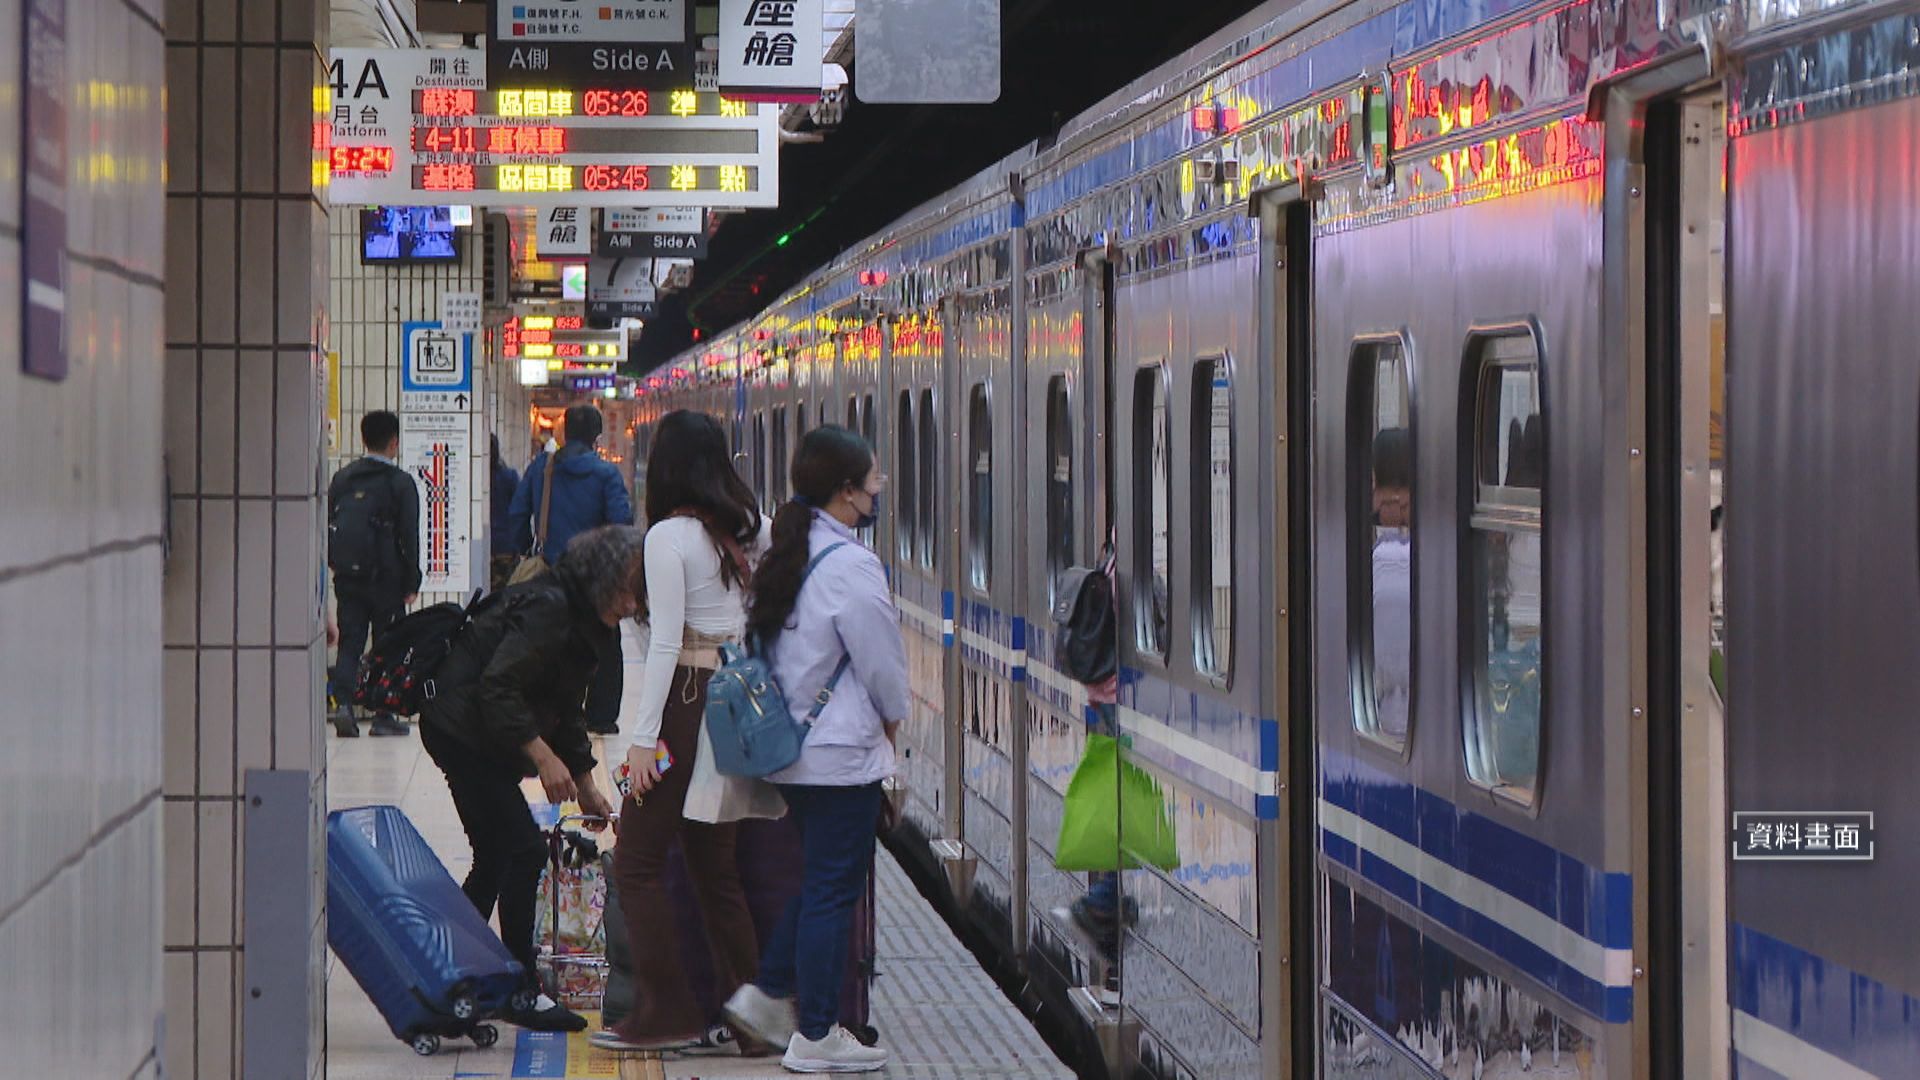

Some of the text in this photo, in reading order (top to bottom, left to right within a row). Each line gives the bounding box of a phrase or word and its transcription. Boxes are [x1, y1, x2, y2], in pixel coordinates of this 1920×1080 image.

[430, 57, 470, 75] 開往
[509, 47, 549, 70] A側
[592, 49, 674, 71] Side A
[415, 75, 484, 87] Destination
[499, 88, 573, 117] 區間車
[584, 90, 648, 117] 05:26
[480, 117, 551, 127] Train Message
[426, 126, 475, 153] 4-11
[509, 155, 561, 164] Next Train
[499, 164, 573, 192] 區間車
[584, 165, 648, 191] 05:45
[653, 235, 697, 248] Side A
